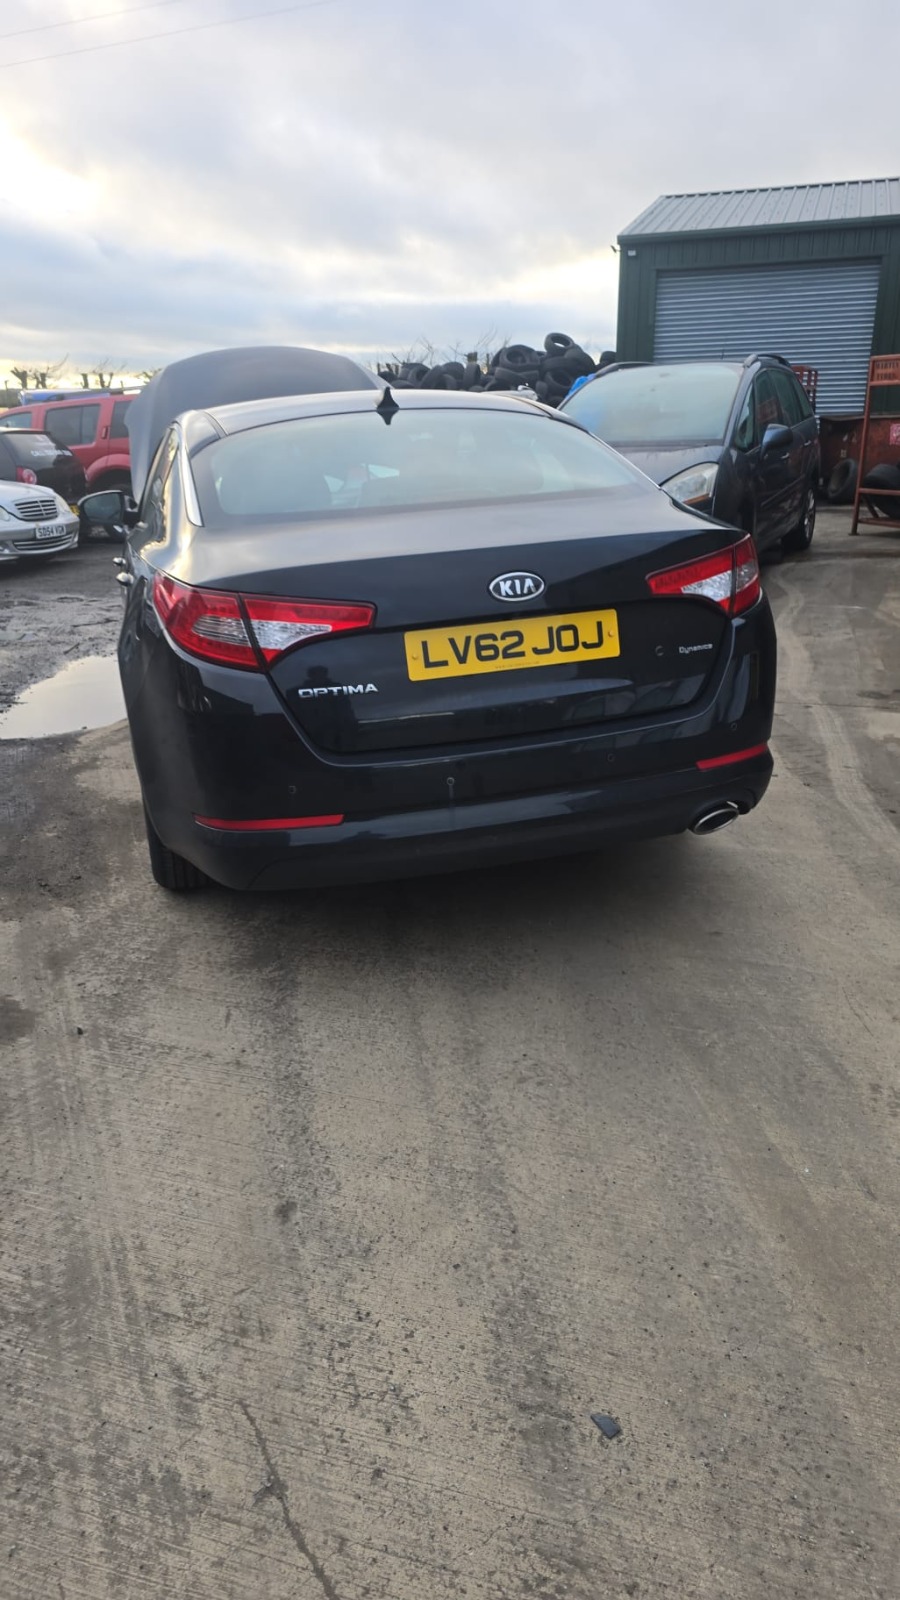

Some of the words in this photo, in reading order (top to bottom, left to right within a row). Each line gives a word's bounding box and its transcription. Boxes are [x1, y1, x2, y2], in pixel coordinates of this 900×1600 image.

[499, 578, 537, 597] KIA
[421, 630, 525, 669] LV62
[532, 621, 604, 655] JOJ
[678, 643, 713, 654] Dynamics
[298, 683, 379, 698] OPTIMA
